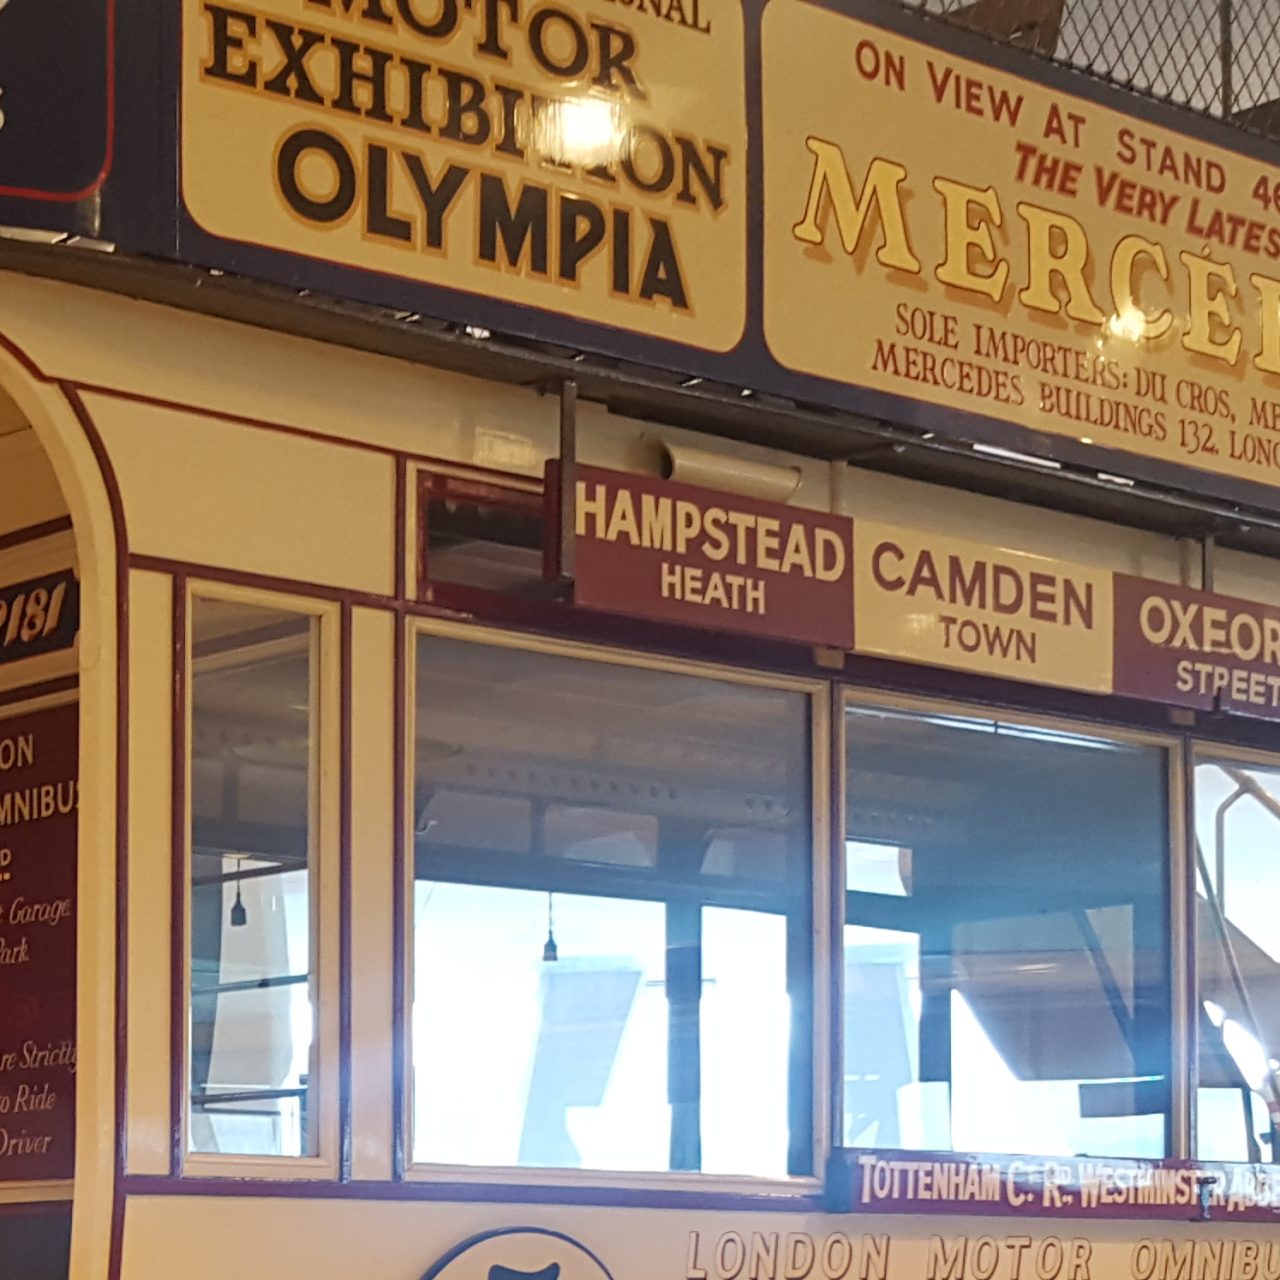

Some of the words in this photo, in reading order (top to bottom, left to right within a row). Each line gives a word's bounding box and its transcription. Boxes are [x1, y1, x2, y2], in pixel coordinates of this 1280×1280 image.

[312, 0, 648, 101] OTOR
[203, 5, 729, 211] EXHIBION
[855, 39, 905, 92] ON
[1116, 126, 1226, 195] STAND
[277, 128, 690, 311] OLYMPIA
[1014, 142, 1083, 199] THE
[1094, 164, 1181, 227] VERY
[872, 338, 1025, 407] MERCEDES
[1039, 381, 1167, 442] BUILDINGS
[895, 302, 960, 350] SOLE
[973, 321, 1128, 391] IMPORTERS:
[1134, 366, 1168, 405] DU
[1176, 378, 1236, 424] CROS,
[575, 480, 846, 583] HAMPSTEAD
[4, 582, 67, 648] 181
[661, 562, 767, 615] HEATH
[871, 541, 1093, 630] CAMDEN
[938, 615, 1037, 664] TOWN
[8, 896, 72, 926] Garage
[14, 1082, 58, 1114] Ride
[858, 1155, 1000, 1205] TOTTENHAM
[1078, 1162, 1227, 1211] WESTMINSTR
[686, 1231, 890, 1280] LONDON
